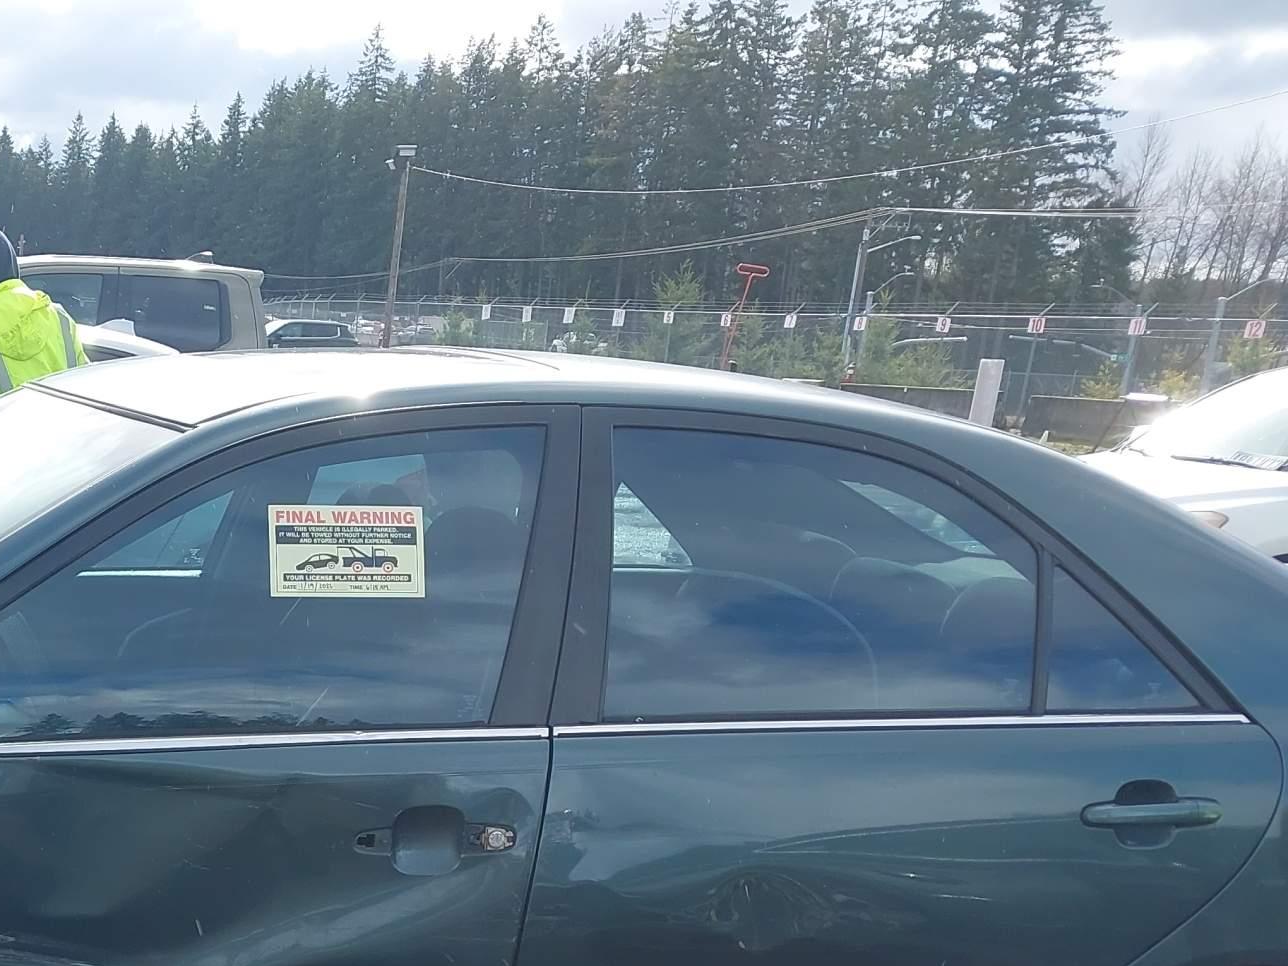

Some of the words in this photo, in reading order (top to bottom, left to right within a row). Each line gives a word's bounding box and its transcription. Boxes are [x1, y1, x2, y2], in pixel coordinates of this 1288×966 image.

[1031, 319, 1042, 332] 10
[1132, 320, 1144, 333] 11
[1248, 322, 1262, 336] 12
[275, 510, 326, 524] FINAL
[331, 511, 415, 525] WARNING
